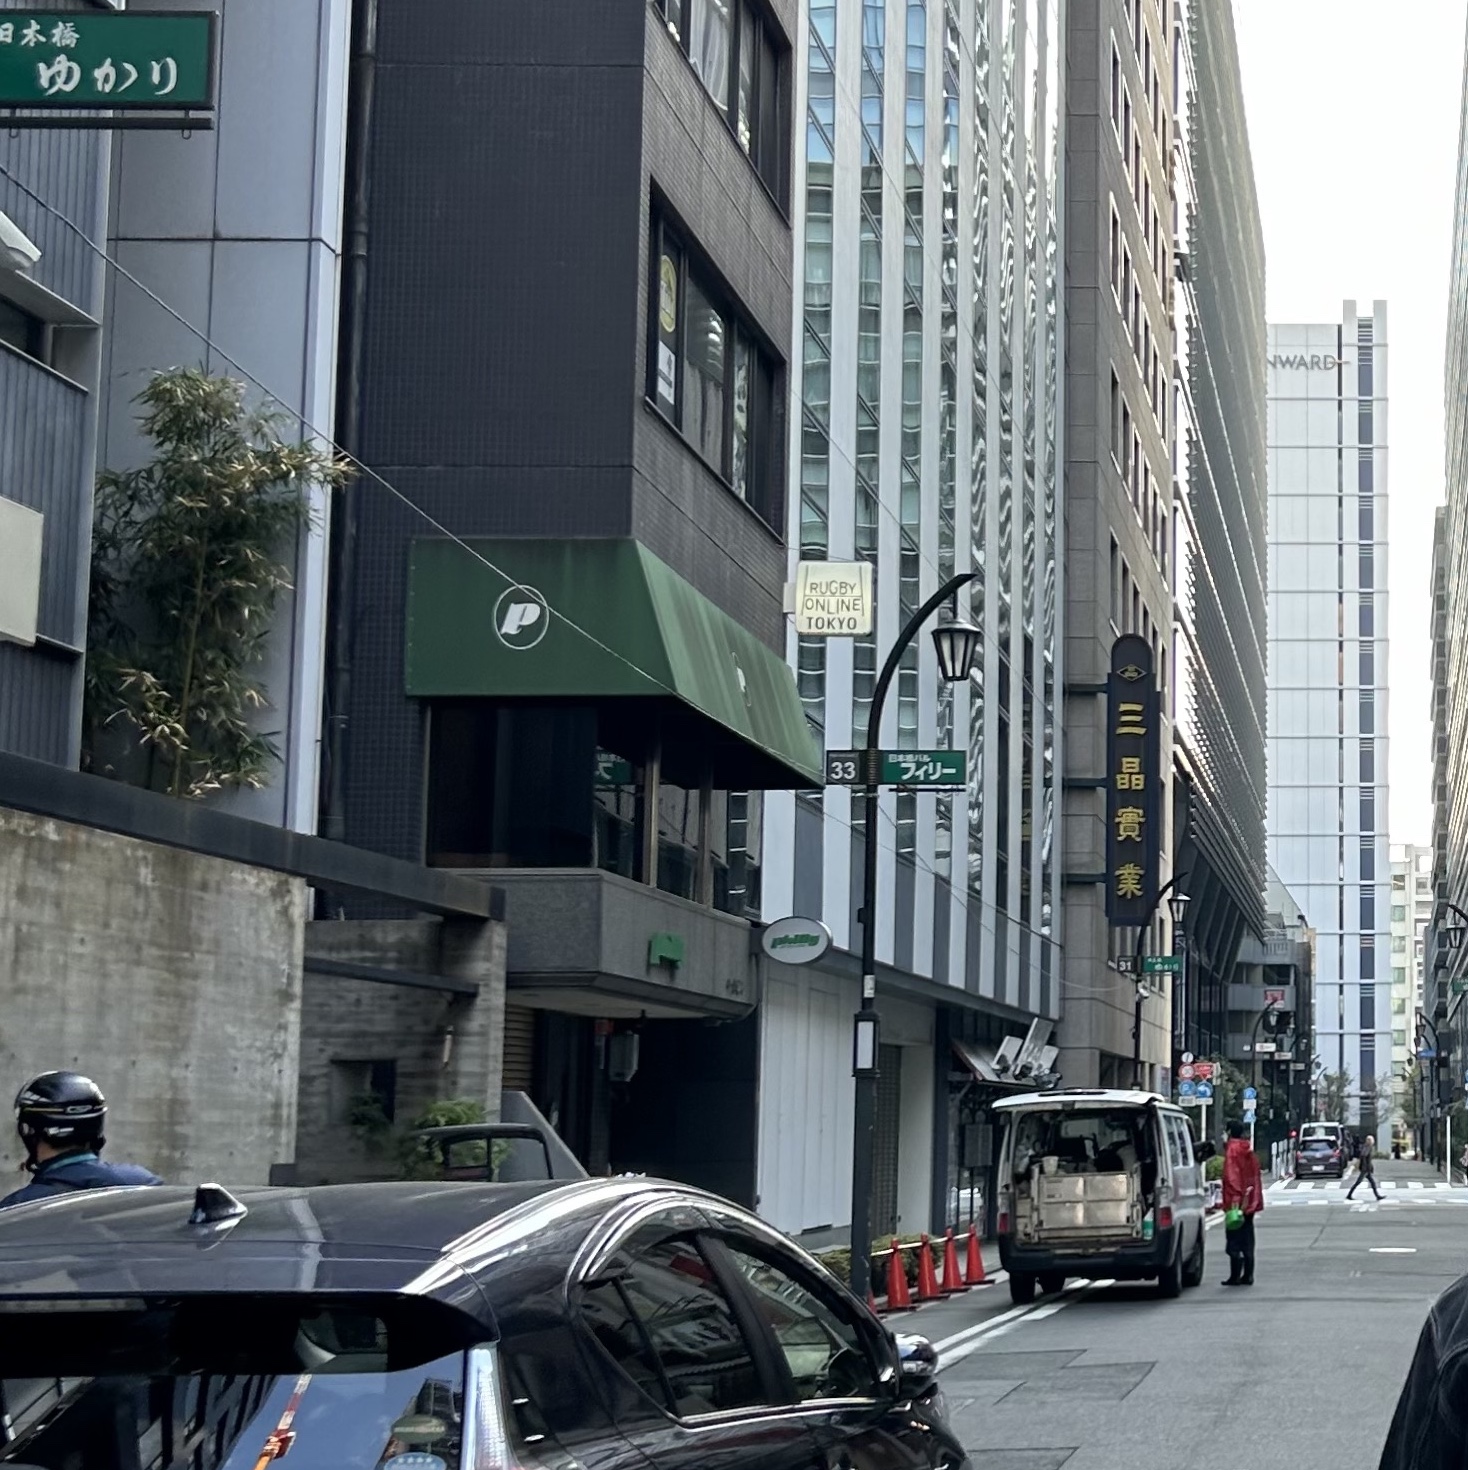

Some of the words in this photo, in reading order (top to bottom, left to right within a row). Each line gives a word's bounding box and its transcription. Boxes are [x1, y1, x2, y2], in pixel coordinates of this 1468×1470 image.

[0, 19, 81, 48] 日本橋
[37, 53, 178, 96] ゆかり
[809, 580, 857, 595] RUGBY
[804, 597, 862, 615] ONLINE
[806, 616, 858, 630] TOKYO
[831, 761, 856, 780] 33
[901, 762, 957, 781] フィリー
[1115, 703, 1147, 899] 三晶實業
[1119, 961, 1132, 971] 31
